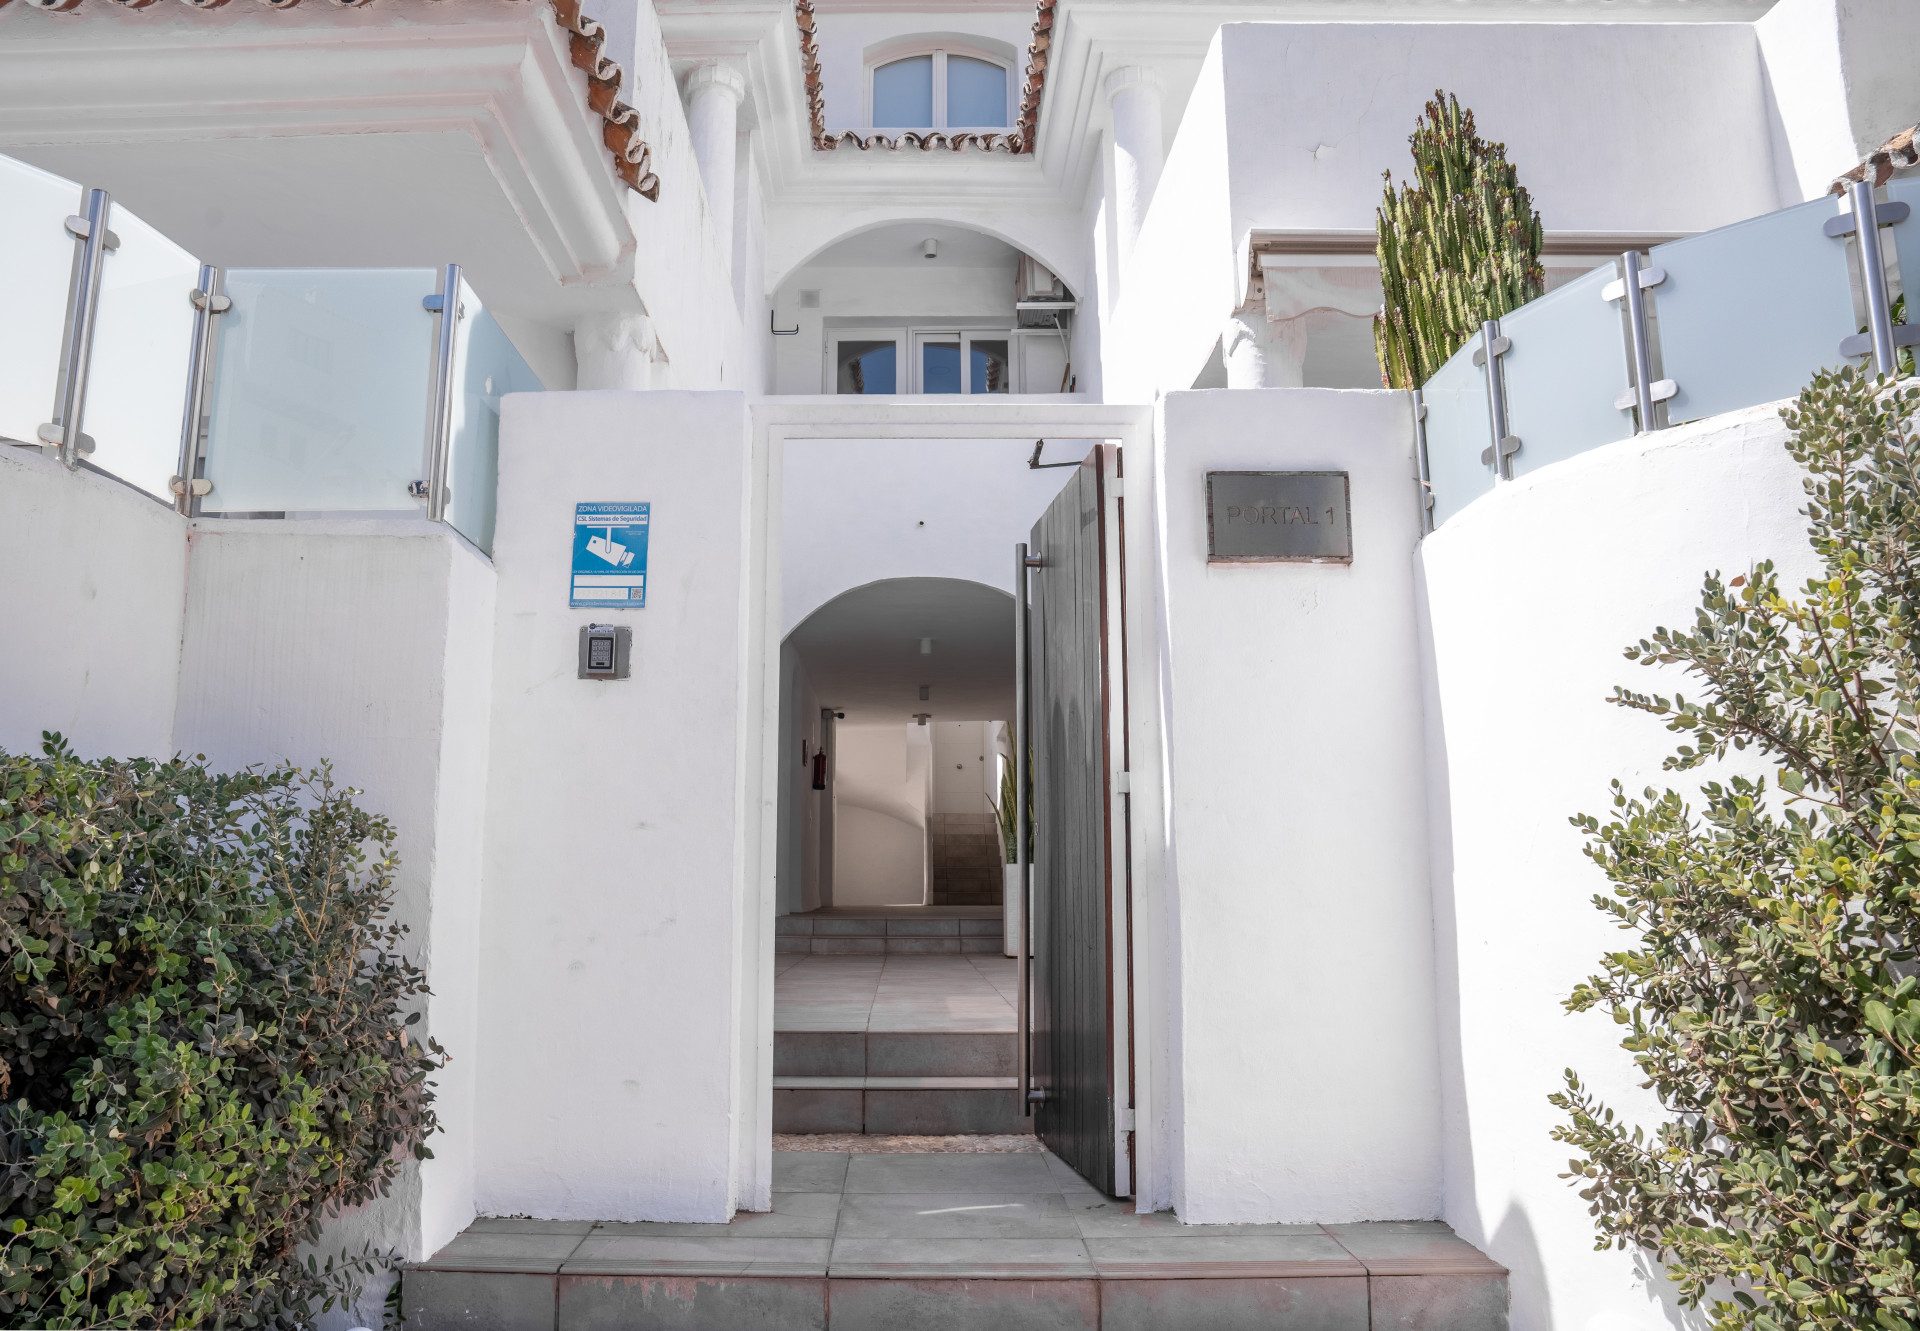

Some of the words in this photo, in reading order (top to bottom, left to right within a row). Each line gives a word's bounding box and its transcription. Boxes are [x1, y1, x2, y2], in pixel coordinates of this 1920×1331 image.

[620, 515, 647, 523] Seguridad
[1226, 505, 1319, 525] PORTAL
[1325, 506, 1334, 525] 1
